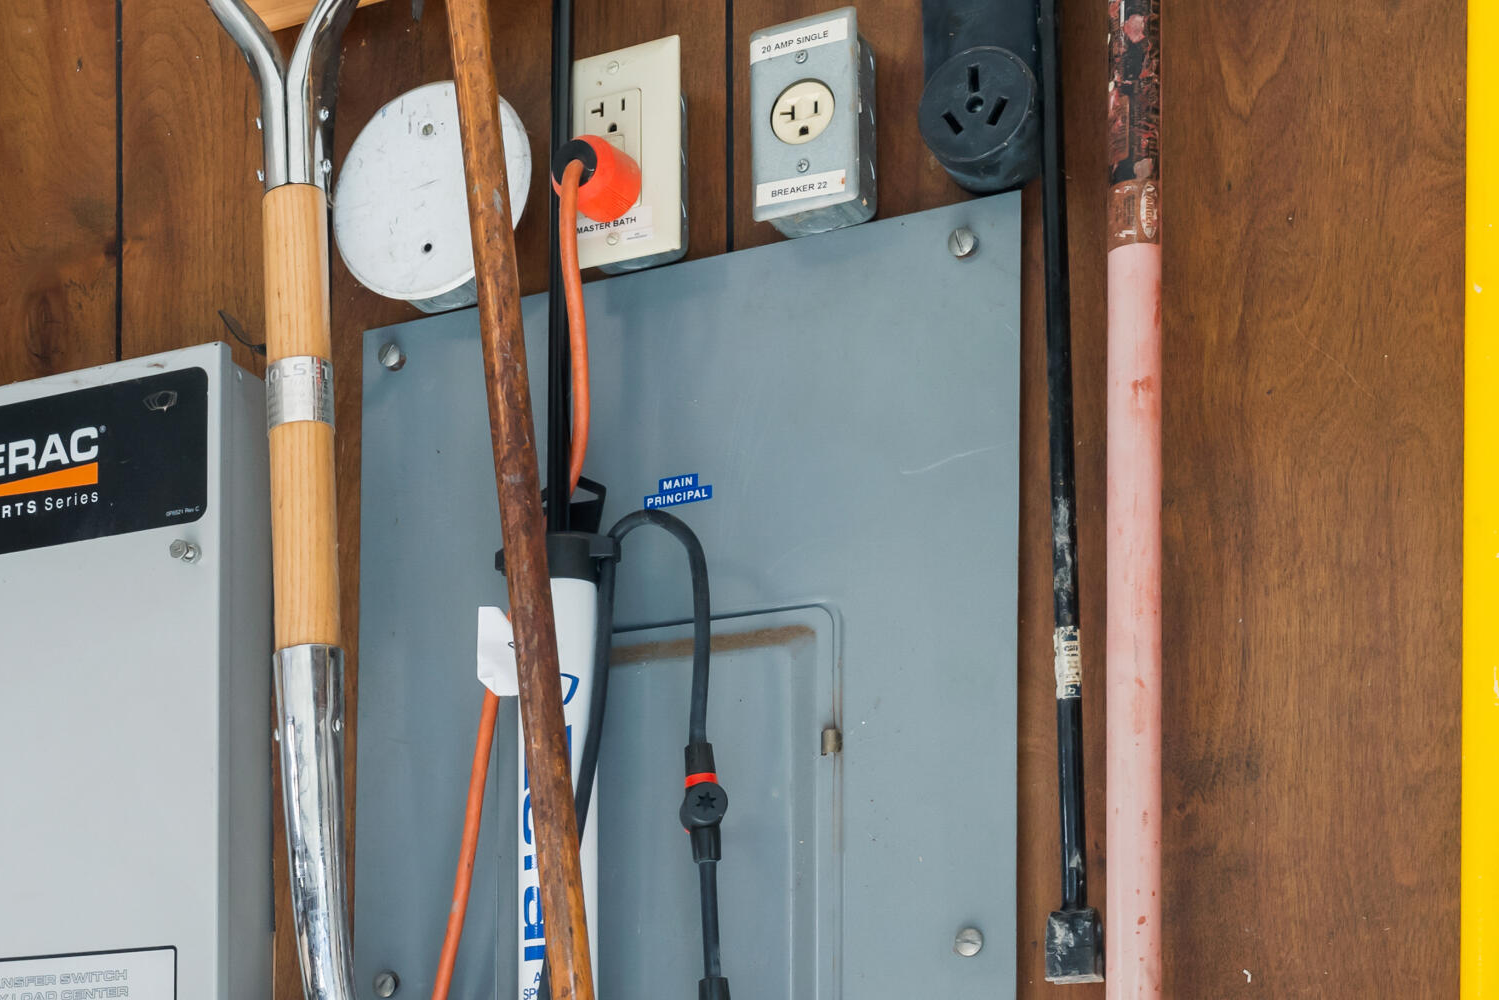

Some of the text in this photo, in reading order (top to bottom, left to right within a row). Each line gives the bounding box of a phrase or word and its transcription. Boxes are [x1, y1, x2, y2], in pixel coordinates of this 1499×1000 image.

[762, 30, 829, 54] 20 AMP SINGLE
[771, 181, 829, 198] BREAKER 22
[577, 216, 636, 234] MASTER BATH
[663, 476, 693, 490] MAIN
[2, 491, 99, 518] RTS Series
[647, 488, 708, 508] PRINCIPAL
[60, 969, 128, 985] SWITCH
